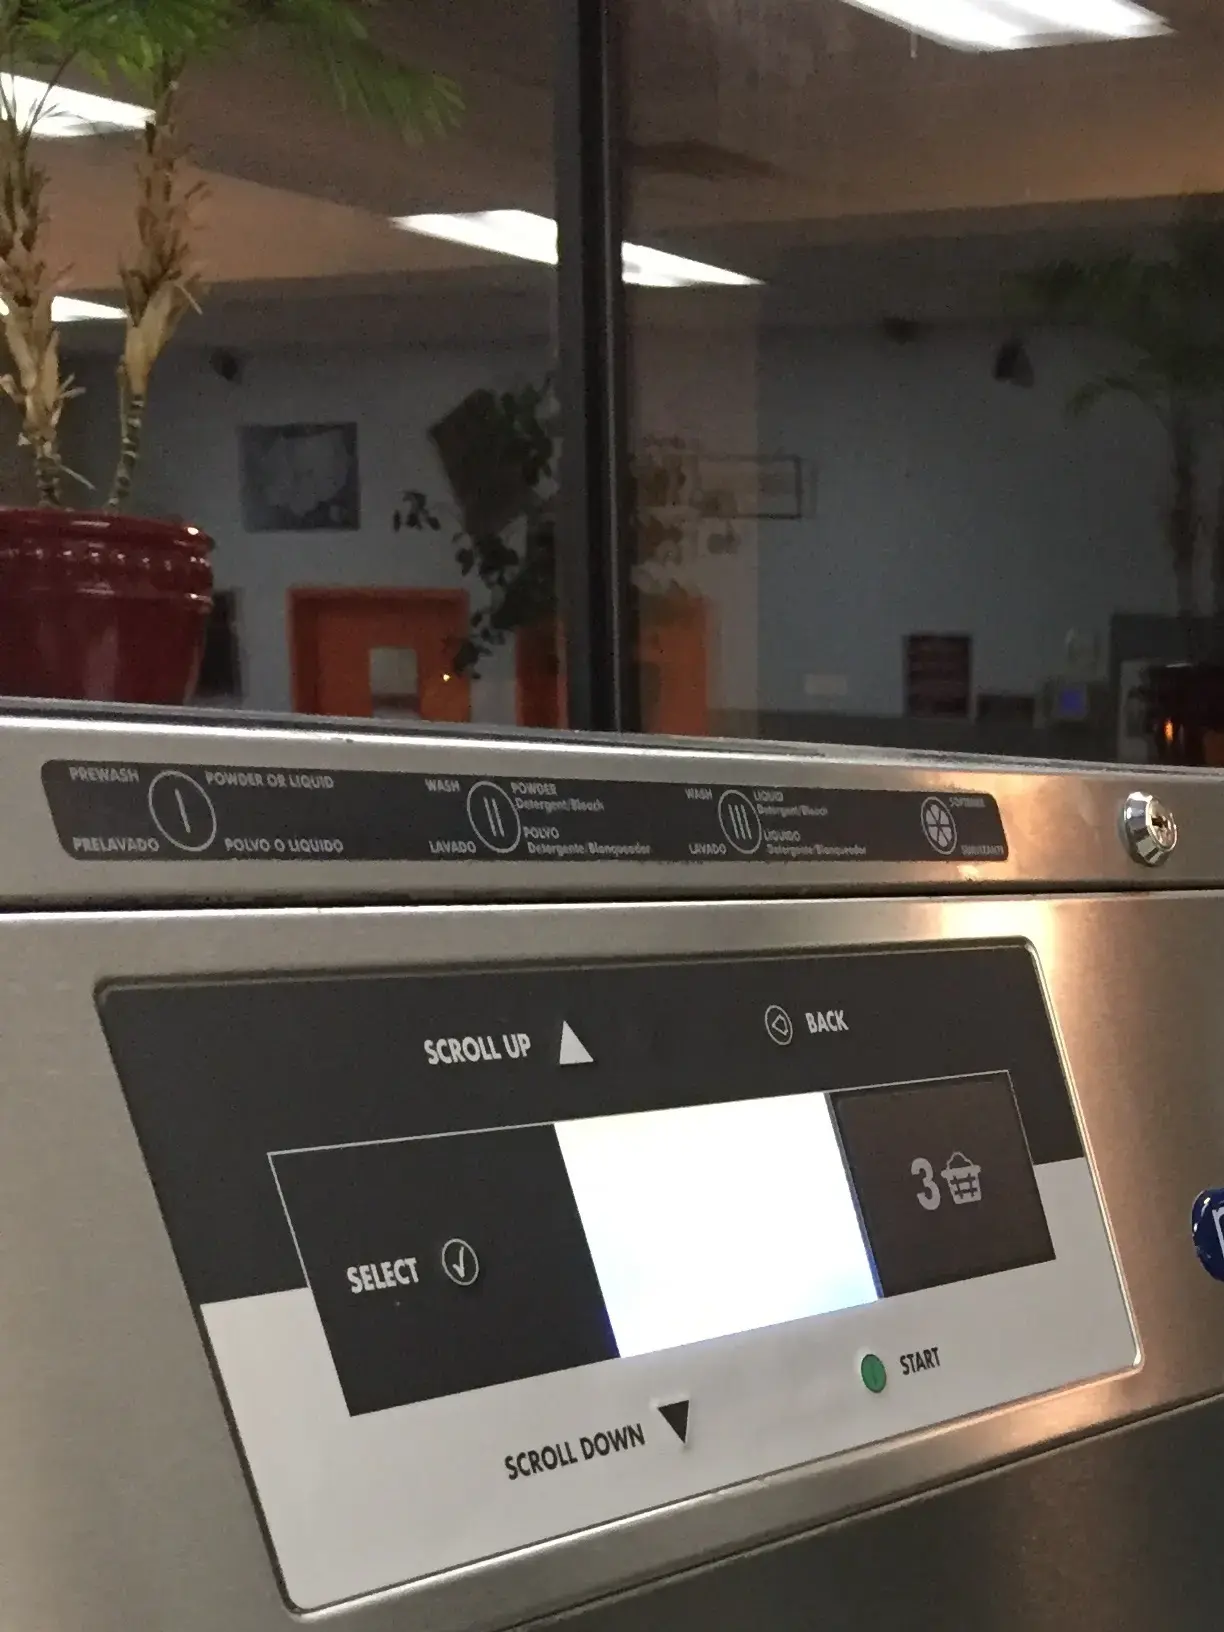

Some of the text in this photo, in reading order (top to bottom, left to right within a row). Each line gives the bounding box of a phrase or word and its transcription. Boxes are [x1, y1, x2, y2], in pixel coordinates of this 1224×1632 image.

[69, 766, 140, 783] PREWASH
[205, 771, 334, 789] POWDER OR LIQUID
[424, 778, 461, 793] WASH
[510, 781, 558, 796] POWDER
[684, 787, 713, 800] WASH
[522, 826, 560, 840] POLVO
[72, 837, 160, 852] PRELAVADO
[224, 838, 270, 853] POLVO
[275, 839, 286, 852] O
[428, 840, 477, 855] LAVADO
[689, 842, 727, 856] LAVADO
[805, 1009, 849, 1035] BACK
[423, 1032, 532, 1067] SCROLL UP
[909, 1156, 942, 1212] 3
[347, 1257, 419, 1295] SELECT
[899, 1346, 942, 1376] START
[504, 1422, 646, 1482] SCROLL DOWN
